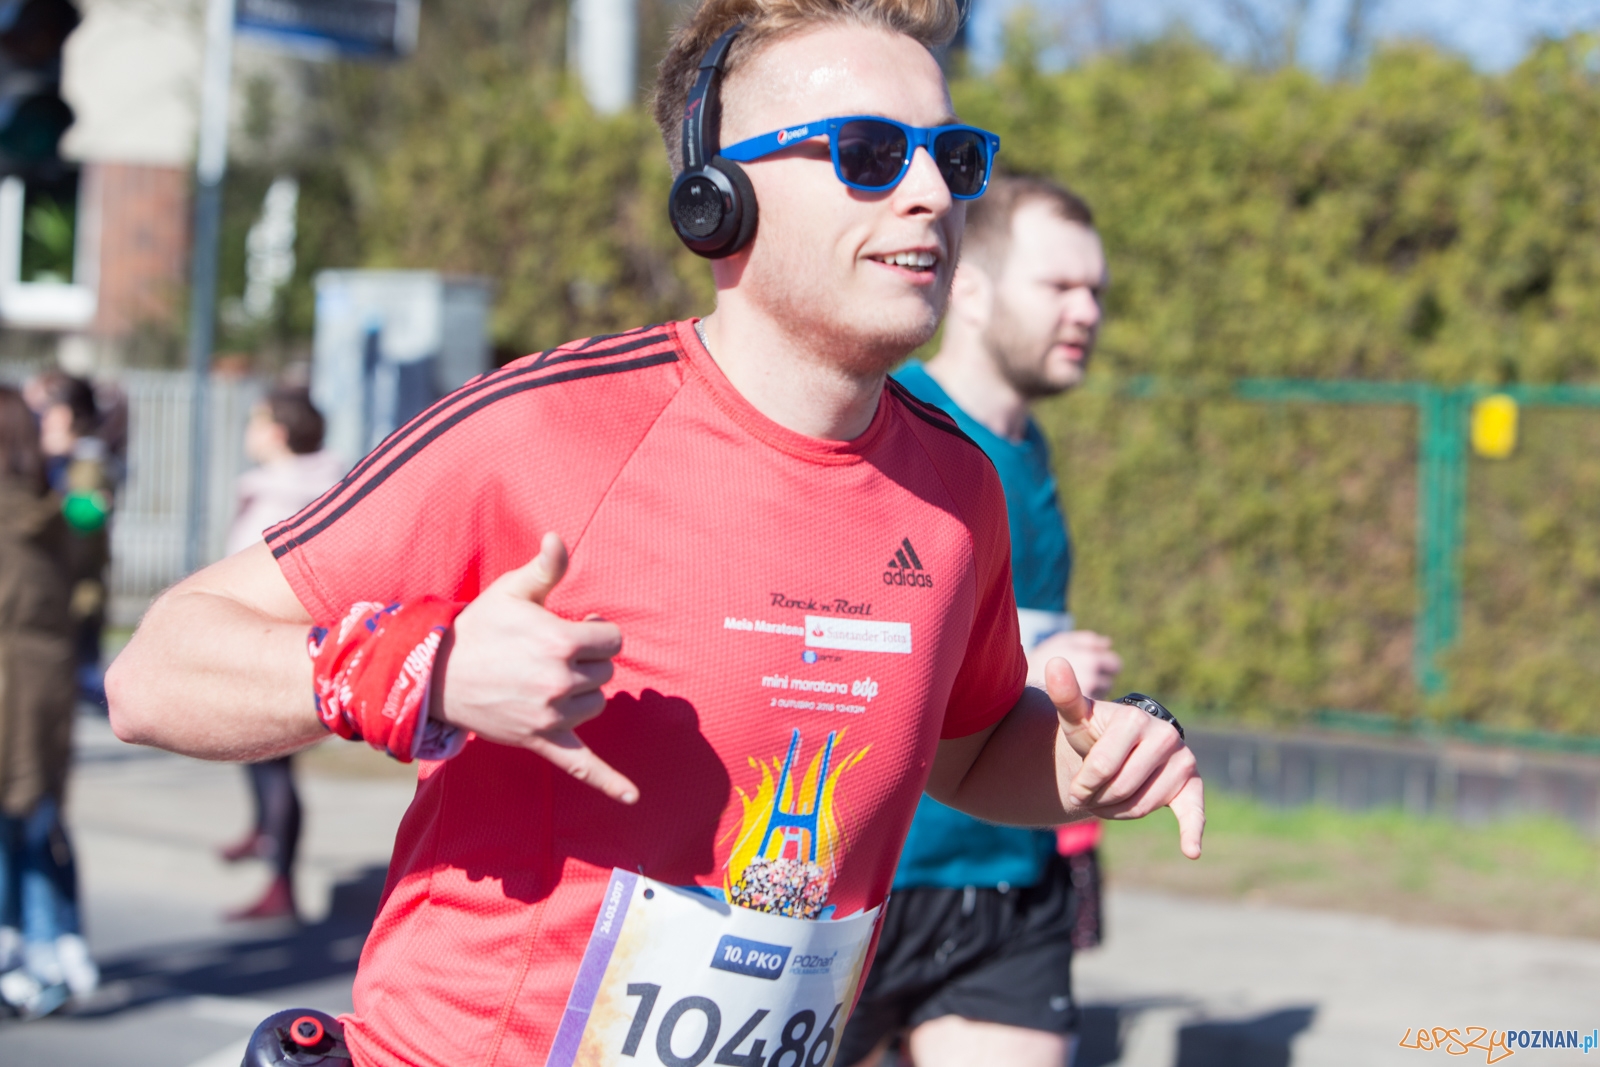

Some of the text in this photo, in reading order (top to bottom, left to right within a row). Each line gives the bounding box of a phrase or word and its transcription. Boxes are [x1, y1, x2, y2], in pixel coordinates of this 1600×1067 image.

[787, 125, 808, 141] pepsi
[883, 569, 933, 588] adidas
[770, 592, 817, 611] Rock
[833, 599, 872, 615] Roll
[826, 626, 907, 644] Santander Totta
[761, 674, 879, 703] mini maratona edp
[600, 880, 624, 935] 26.03.2017
[724, 945, 783, 971] 10. PKO
[620, 982, 844, 1067] 10486
